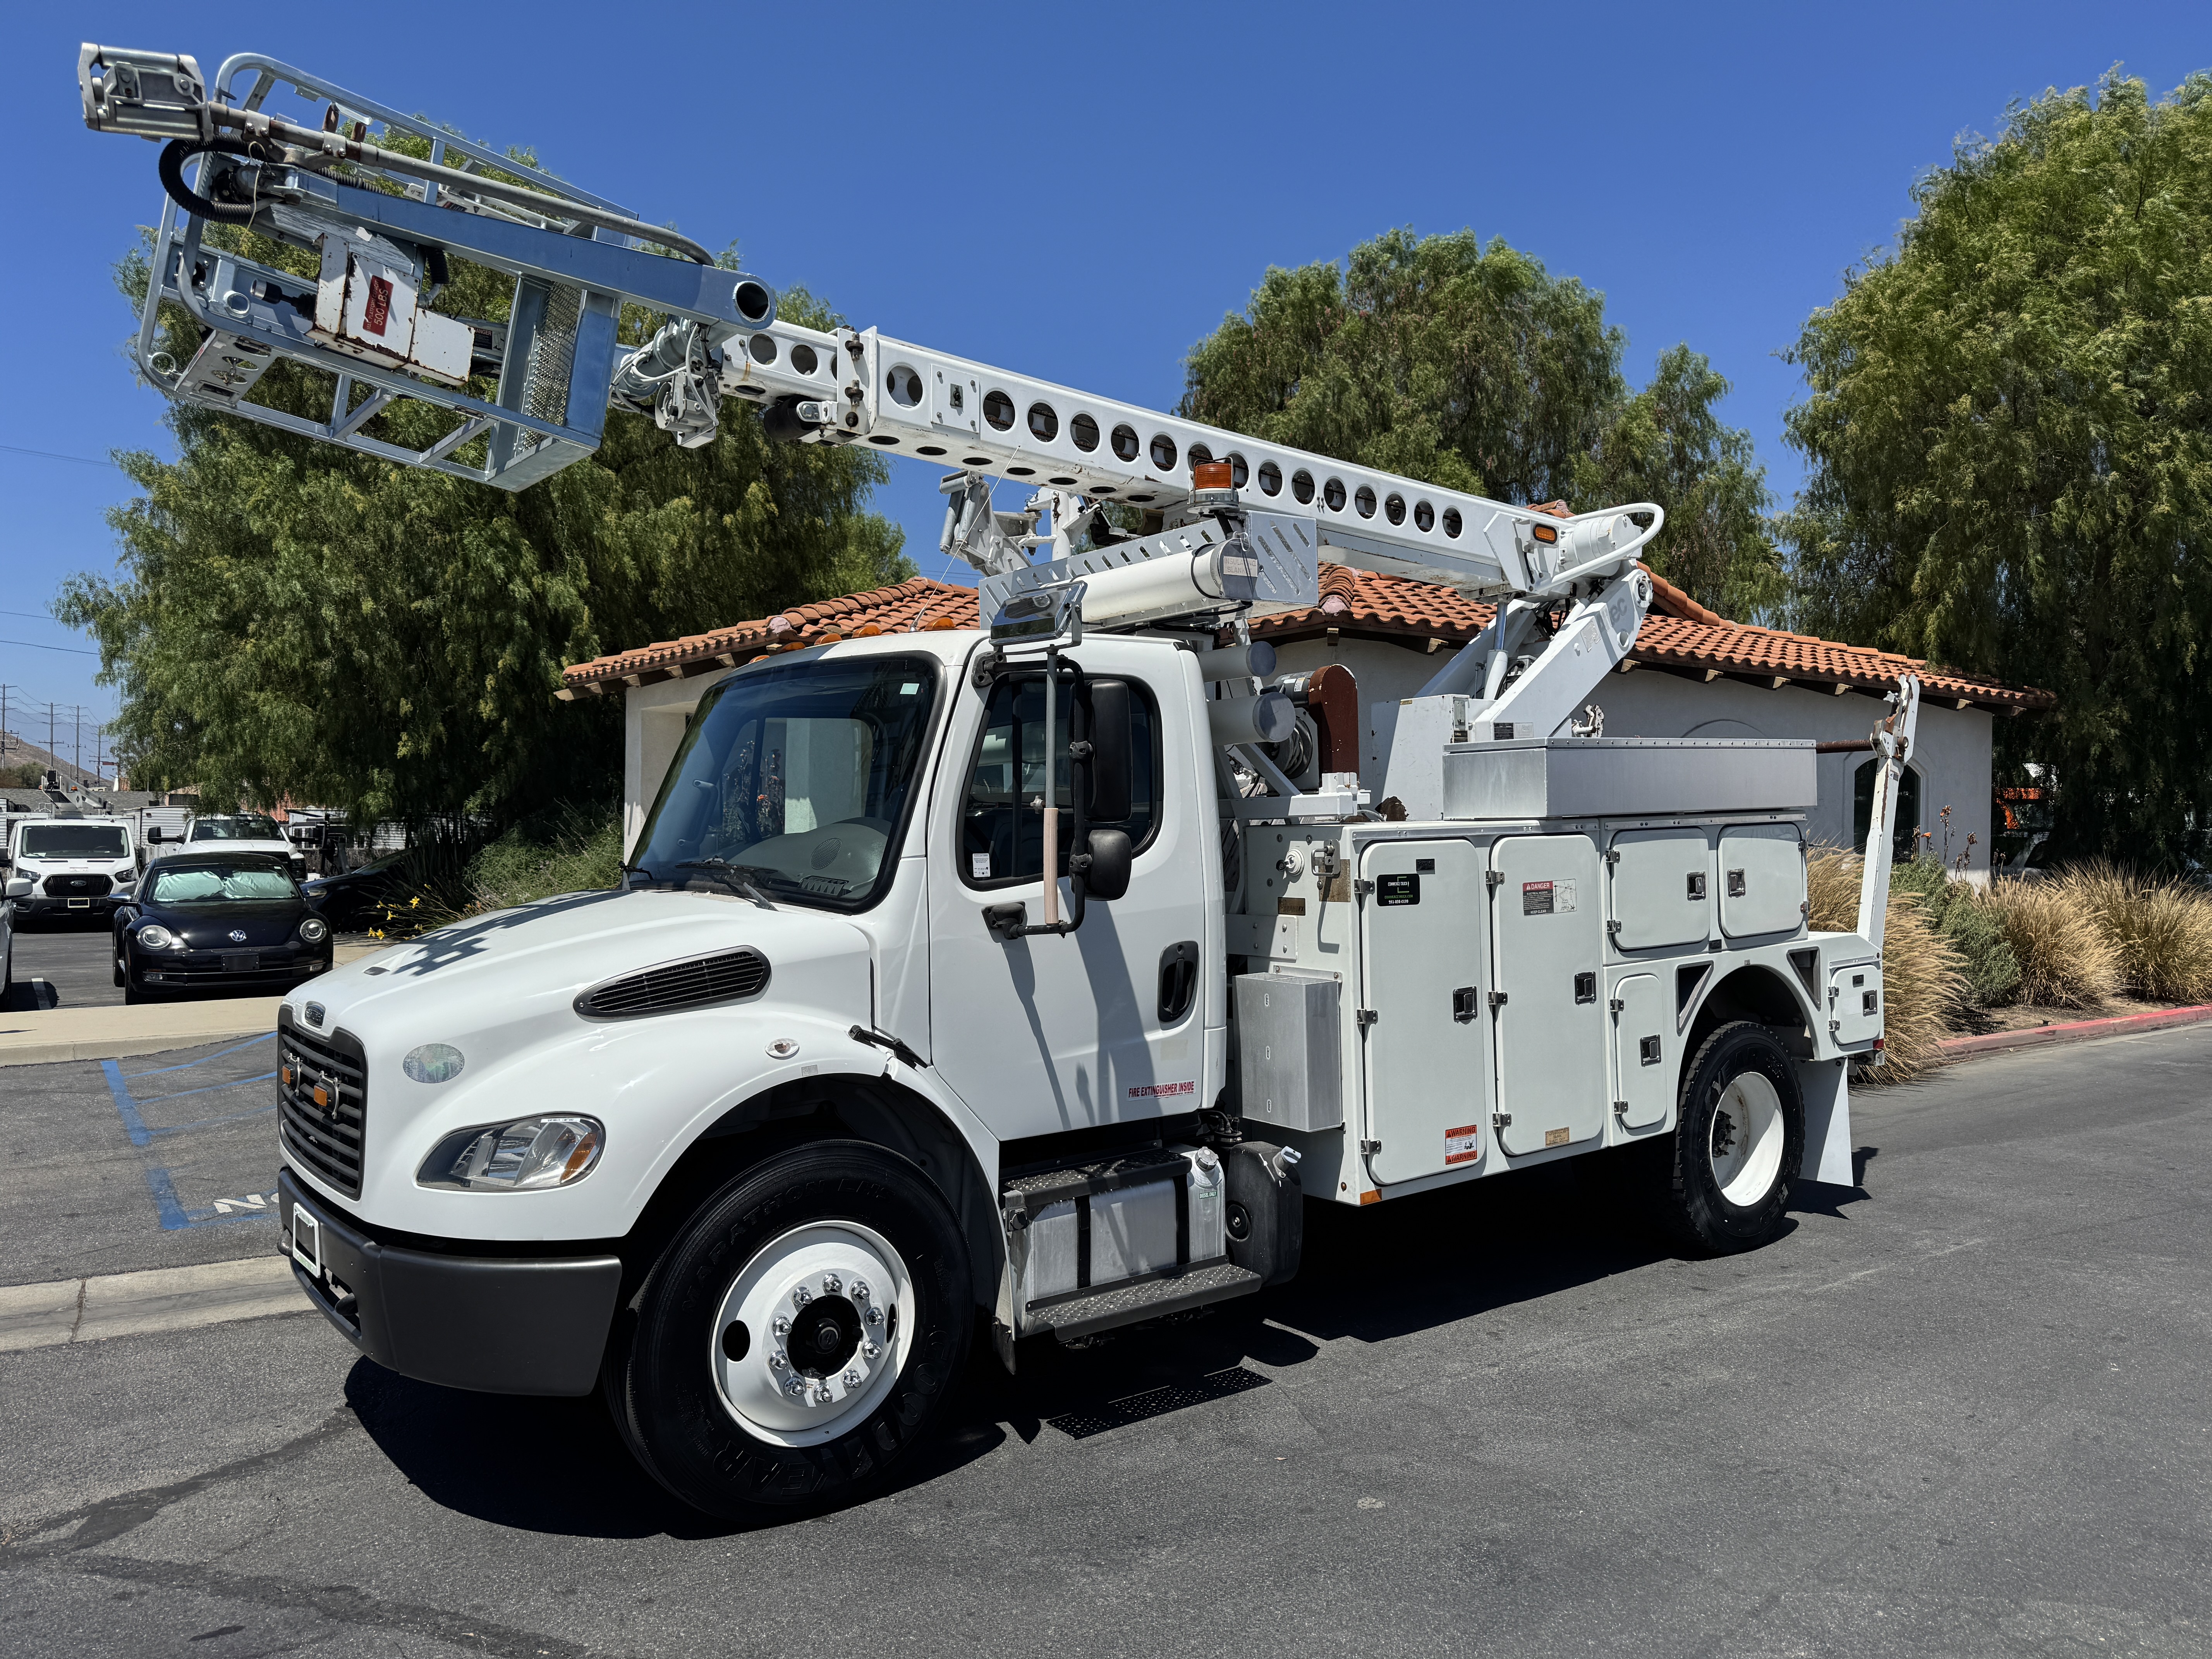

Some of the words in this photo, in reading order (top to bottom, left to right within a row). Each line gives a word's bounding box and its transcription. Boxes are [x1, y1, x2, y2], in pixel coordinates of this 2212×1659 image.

[377, 289, 388, 307] LBS
[374, 308, 385, 326] 500
[1224, 558, 1256, 567] INSULANG
[1128, 1087, 1140, 1097] FIRE
[1141, 1084, 1177, 1096] EXTINGUISHER
[1178, 1081, 1194, 1092] INSIDE
[1451, 1127, 1475, 1136] WARNING
[1451, 1152, 1475, 1162] WARNING
